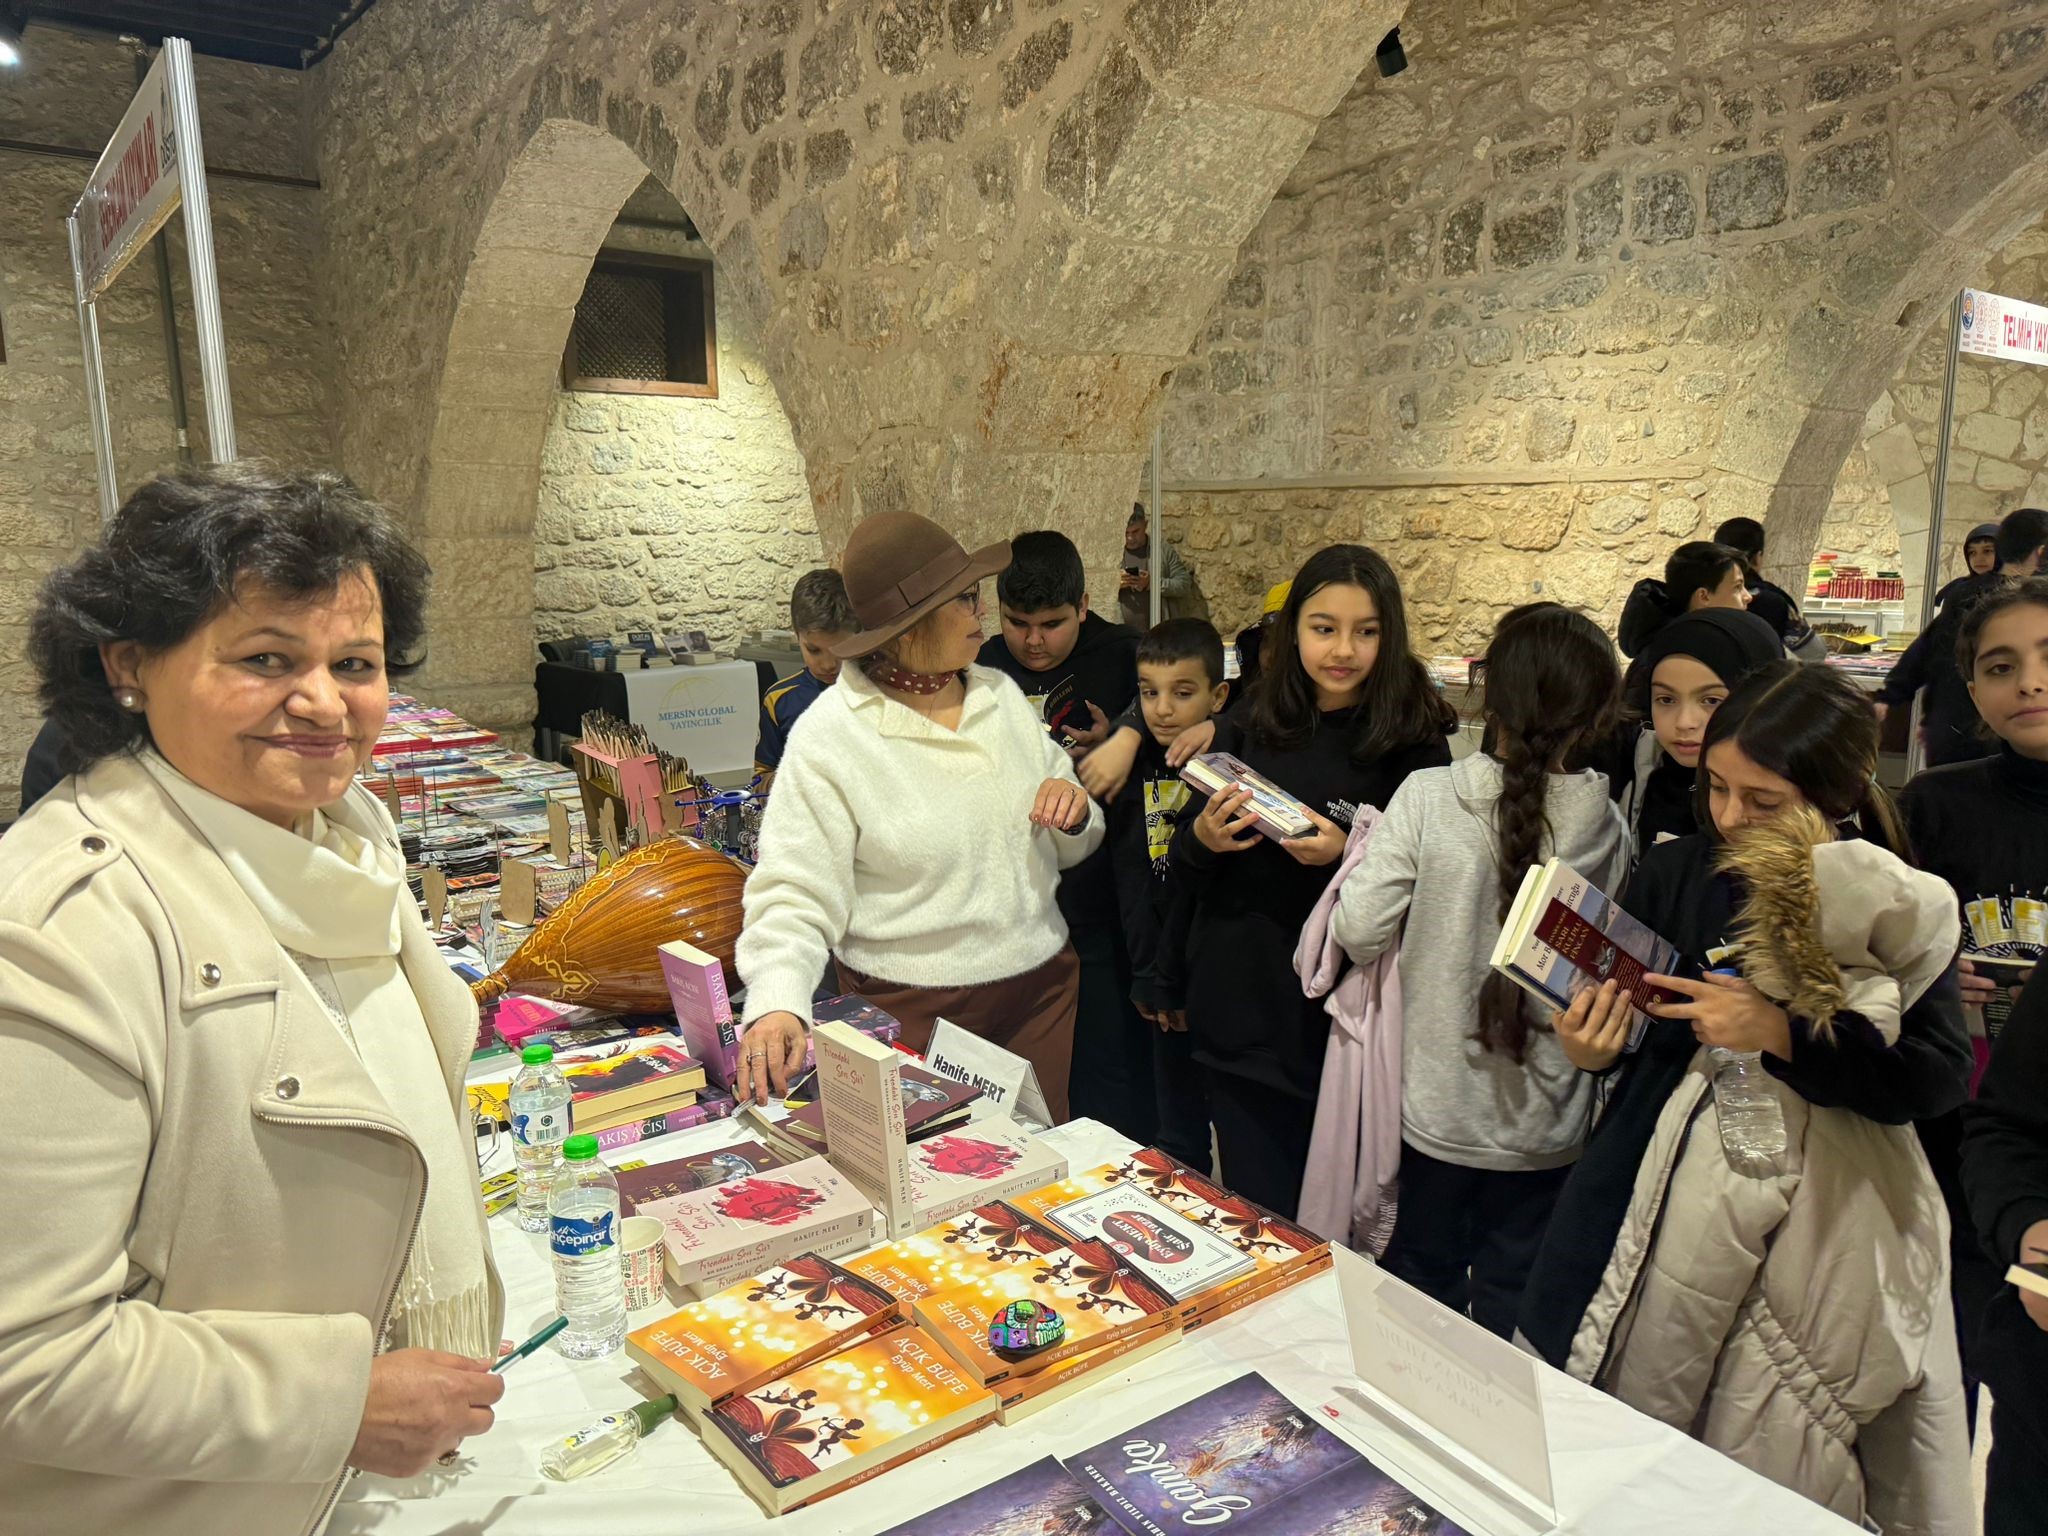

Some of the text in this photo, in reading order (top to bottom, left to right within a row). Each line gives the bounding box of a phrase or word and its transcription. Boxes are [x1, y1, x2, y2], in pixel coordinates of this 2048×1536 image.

[2003, 311, 2033, 351] TELMİH
[659, 706, 737, 722] MERSİN GLOBAL
[670, 717, 722, 731] YAYINCILIK
[1326, 801, 1351, 818] NORTH
[1339, 798, 1352, 810] THE
[1554, 926, 1569, 949] SARI
[1536, 953, 1550, 971] Mor
[711, 972, 727, 1012] BAKIŞ
[719, 1012, 735, 1046] AÇISI
[932, 1053, 1006, 1104] Hanife MERT
[597, 1117, 667, 1146] AKIŞ AÇISI
[1025, 1177, 1041, 1190] MERT
[793, 1223, 841, 1243] HANİFE MERT
[835, 1236, 855, 1247] MERT
[1111, 1219, 1175, 1260] Eyüp MERT
[858, 1263, 921, 1304] ÇIK BÜFE
[887, 1265, 929, 1294] Eyüp Mert
[937, 1299, 972, 1332] BÜFE
[967, 1304, 990, 1323] Mert
[1106, 1325, 1133, 1340] Eyüp Mert
[650, 1330, 728, 1380] AÇIK BÜFE
[683, 1330, 729, 1361] Eyüp Mert
[1046, 1344, 1079, 1362] AÇIK BÜFE
[1113, 1339, 1138, 1356] Eyüp Mert
[769, 1364, 787, 1378] AÇIK
[891, 1354, 936, 1391] Eyüp Mert
[893, 1336, 970, 1395] AÇIK BÜFE
[1057, 1361, 1089, 1381] AÇIK BÜFE
[848, 1435, 945, 1486] AÇIK BÜFE Eyüp Mert
[1084, 1464, 1120, 1497] BAKANER
[1116, 1496, 1145, 1521] YILDIZ
